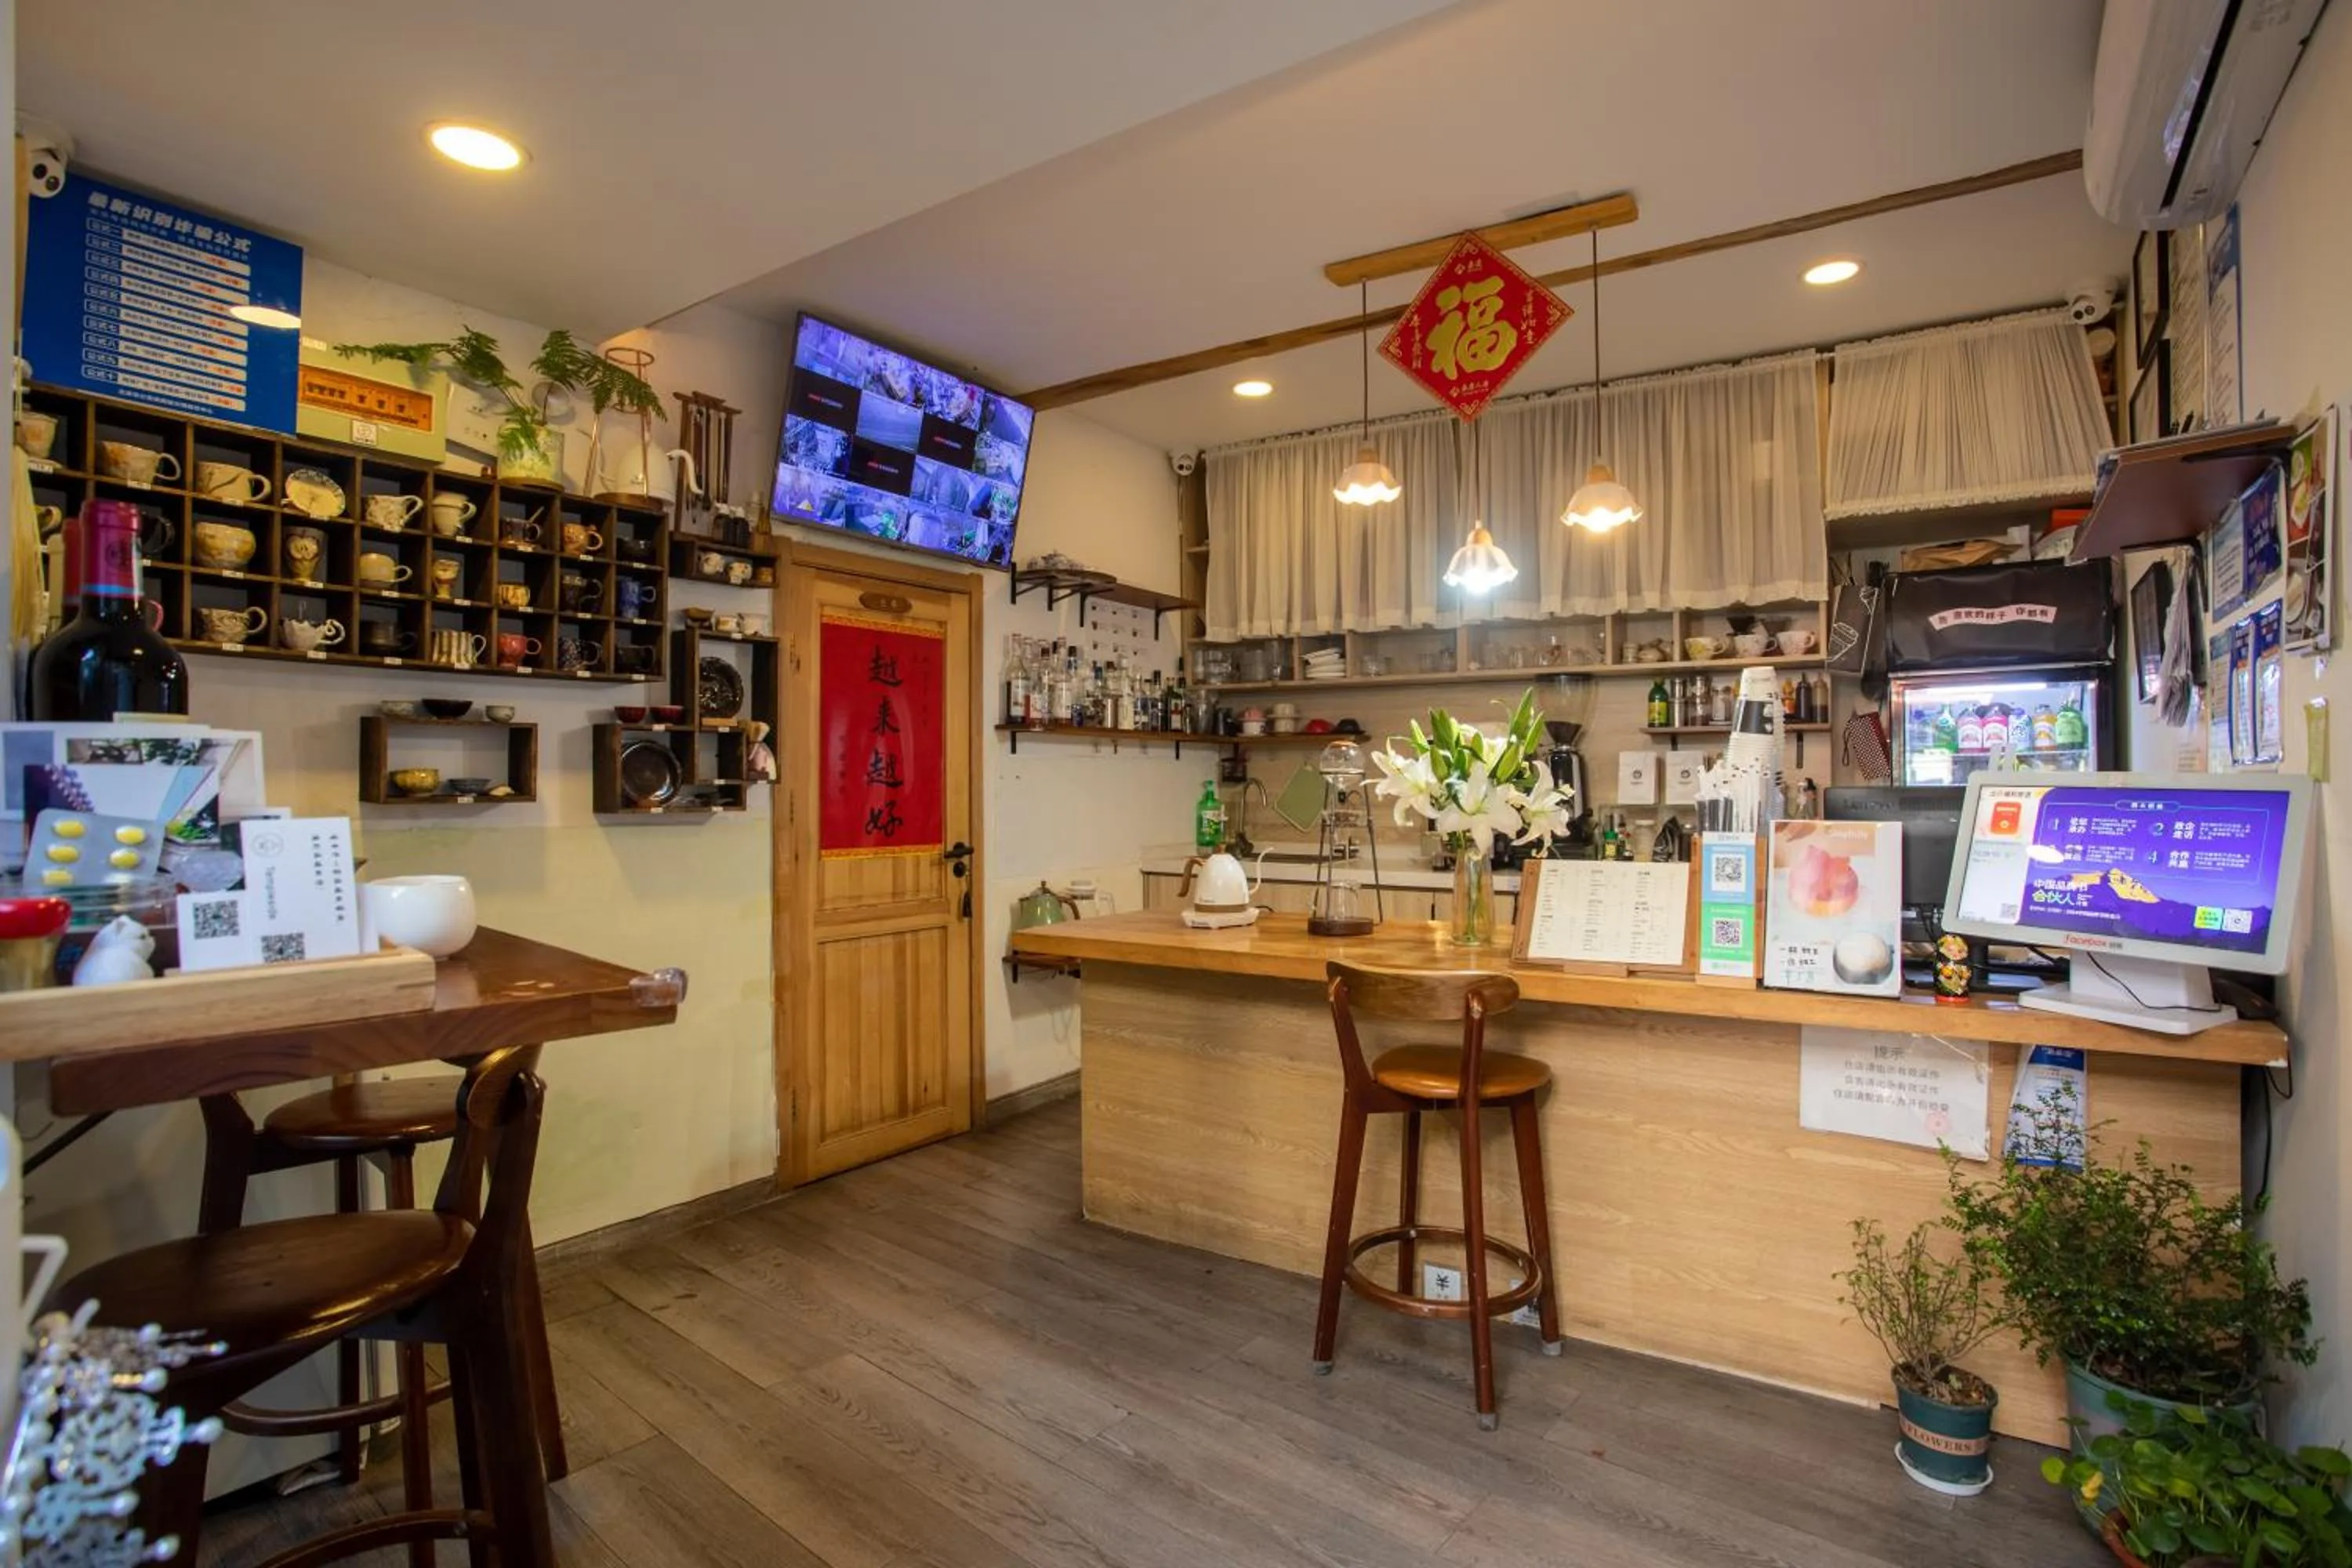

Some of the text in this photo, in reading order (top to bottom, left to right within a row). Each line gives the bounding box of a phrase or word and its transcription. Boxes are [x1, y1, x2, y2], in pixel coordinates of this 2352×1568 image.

[1425, 276, 1518, 380] 福
[865, 644, 904, 837] 越来越好
[2031, 889, 2075, 906] 合伙人
